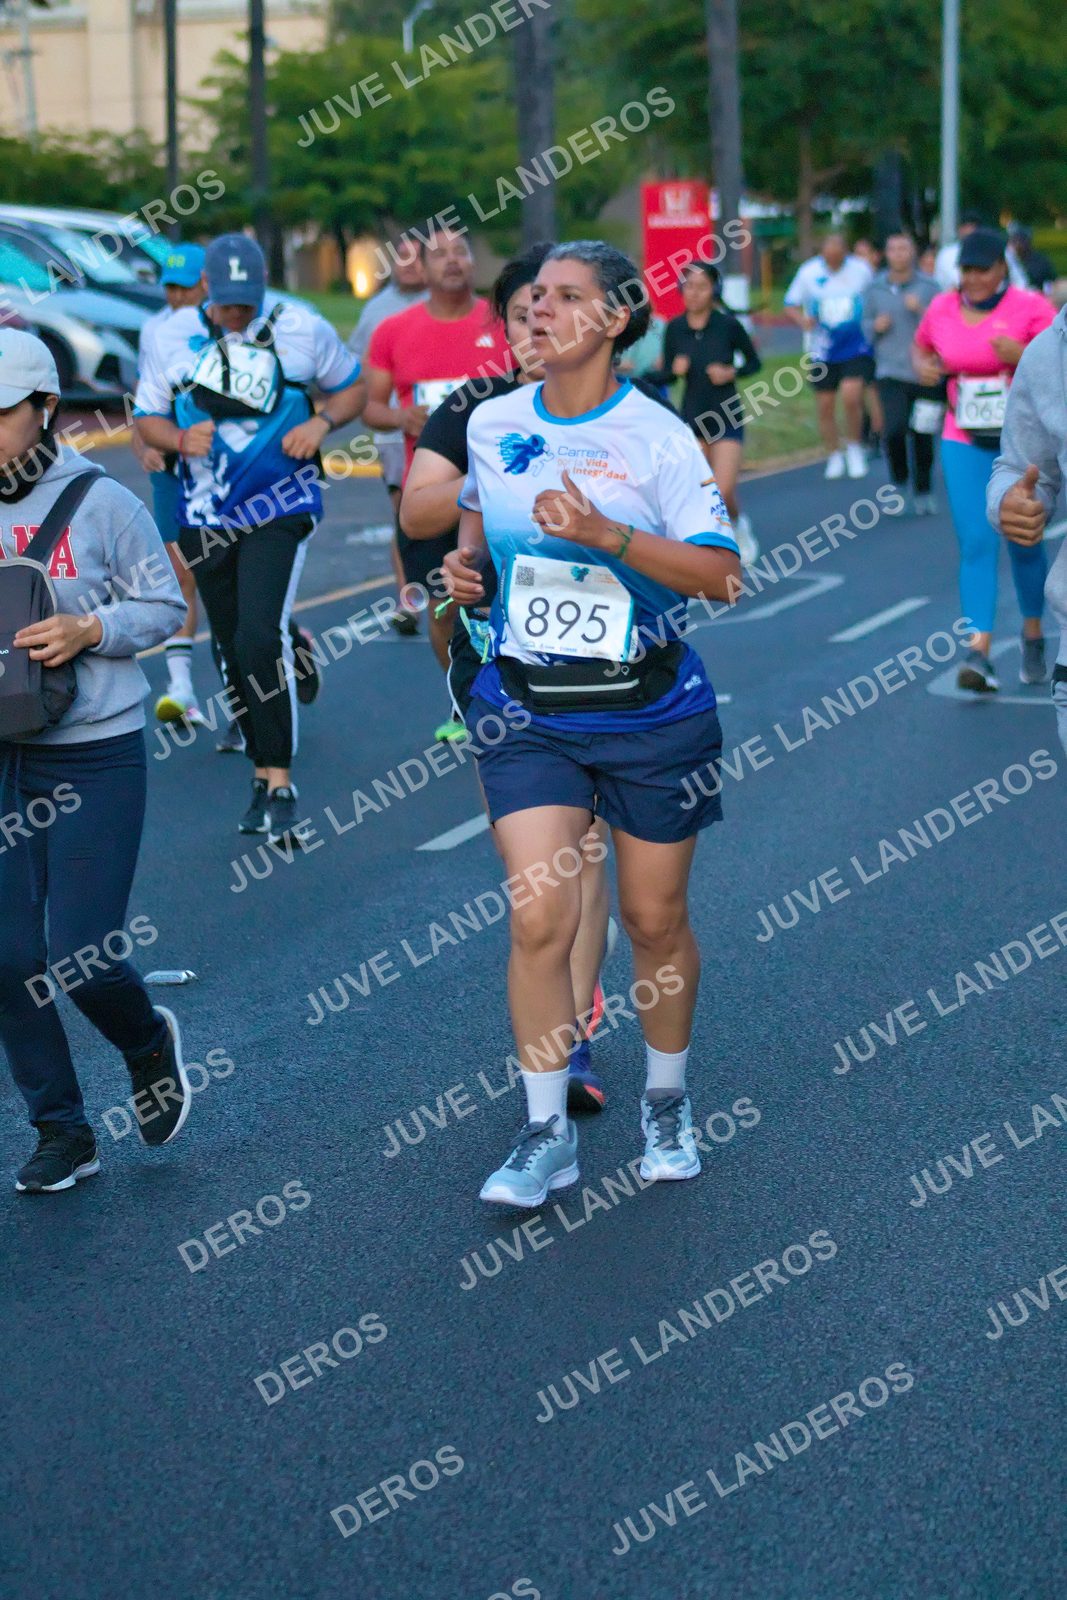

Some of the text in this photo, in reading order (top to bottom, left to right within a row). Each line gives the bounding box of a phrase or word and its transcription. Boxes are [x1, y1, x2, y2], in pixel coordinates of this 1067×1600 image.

[228, 257, 248, 281] L
[557, 445, 609, 459] Carrera
[585, 458, 609, 468] Vida
[572, 466, 628, 481] Integridad
[524, 596, 610, 644] 895
